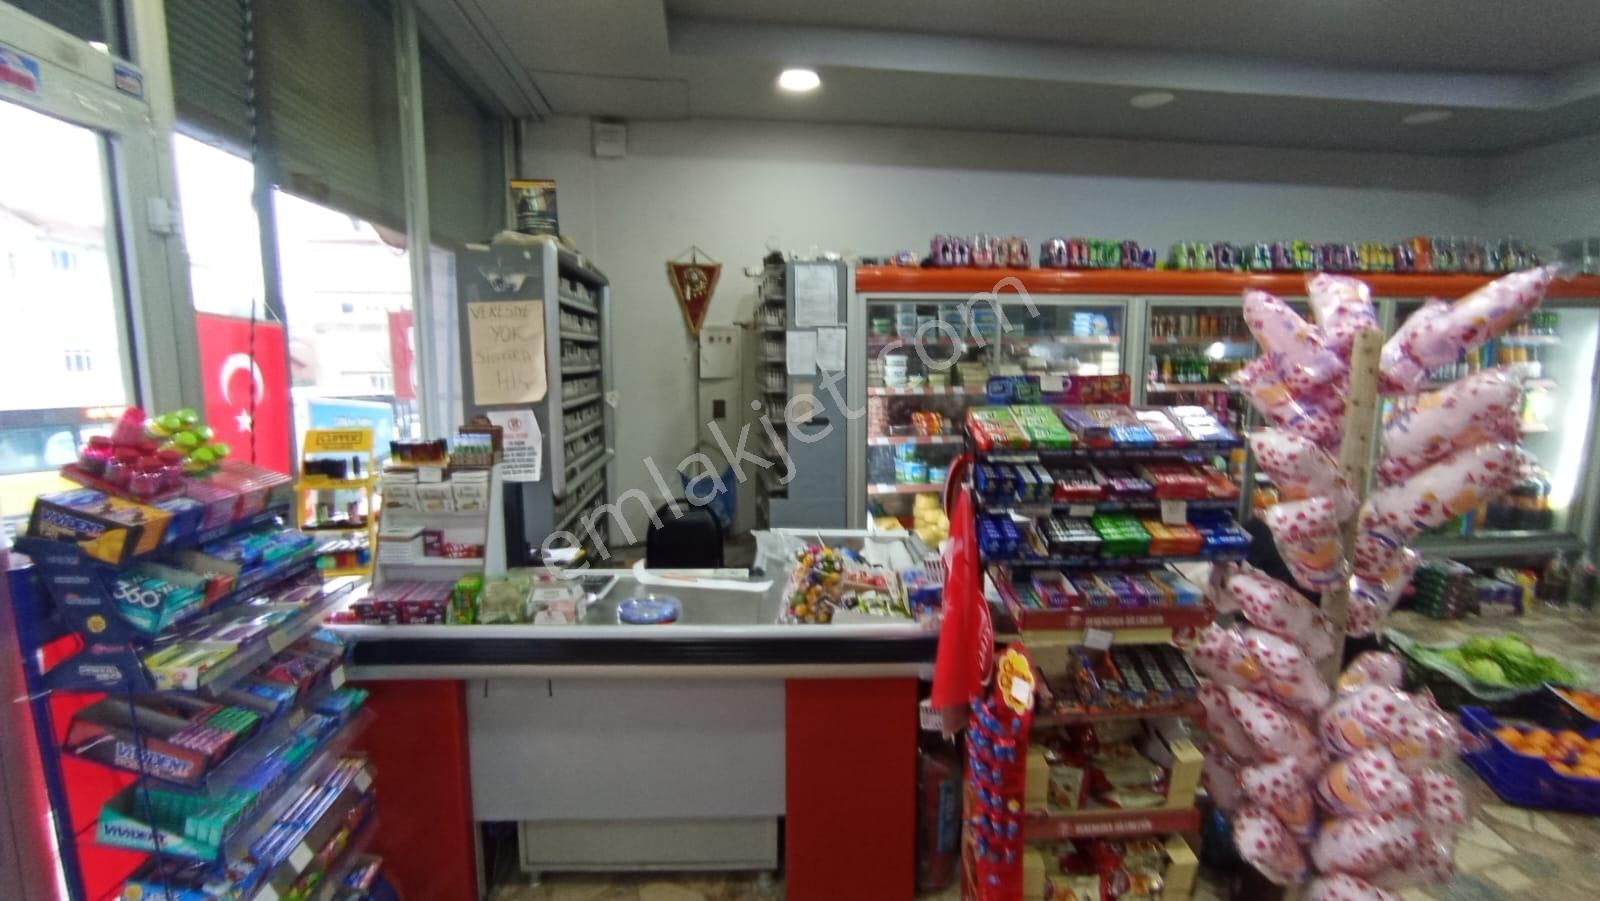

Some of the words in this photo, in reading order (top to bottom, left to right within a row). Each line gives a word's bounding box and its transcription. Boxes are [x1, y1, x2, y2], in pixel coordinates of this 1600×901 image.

[113, 580, 160, 608] 360
[115, 741, 195, 771] VIVIDENT
[104, 823, 166, 843] VIVIDENT
